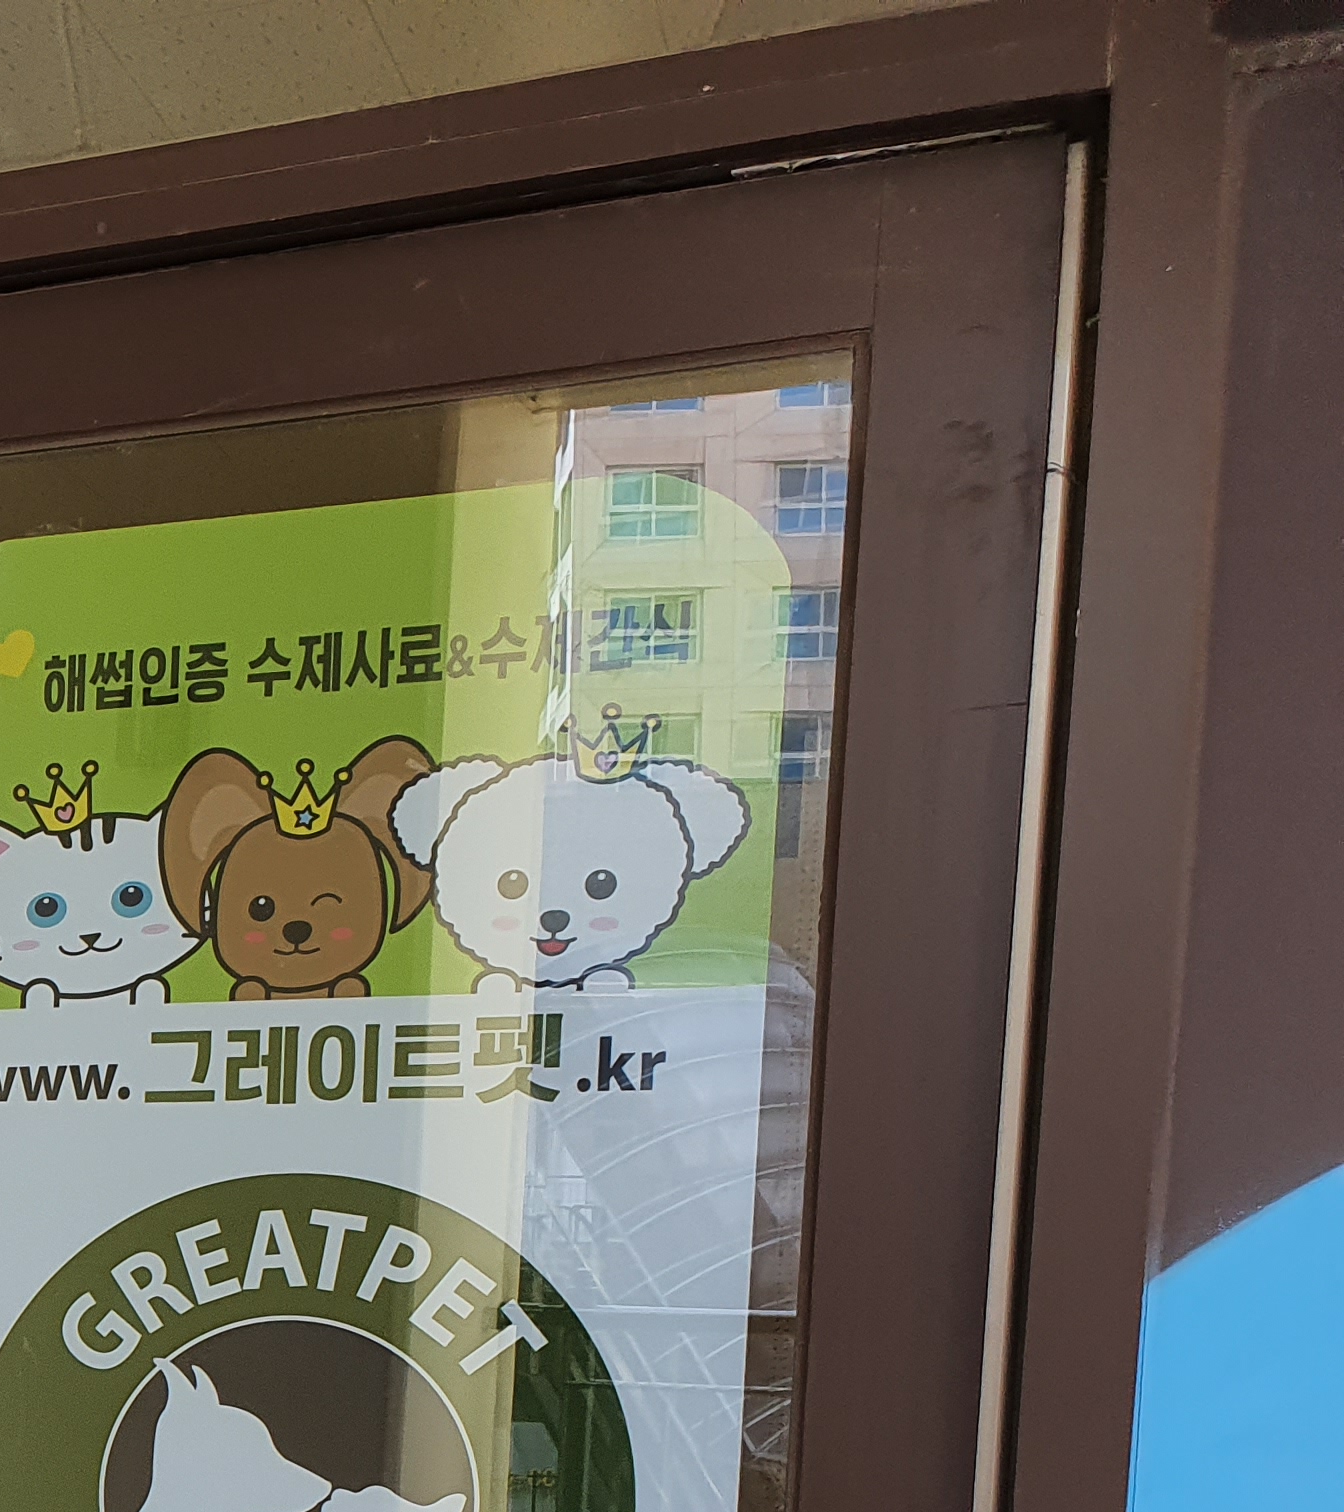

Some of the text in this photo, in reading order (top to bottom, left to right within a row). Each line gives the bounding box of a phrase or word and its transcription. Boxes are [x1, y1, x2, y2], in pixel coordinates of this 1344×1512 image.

[43, 600, 691, 713] 해썹인증 수제사료&수제간식
[61, 1207, 549, 1378] GREATPET
